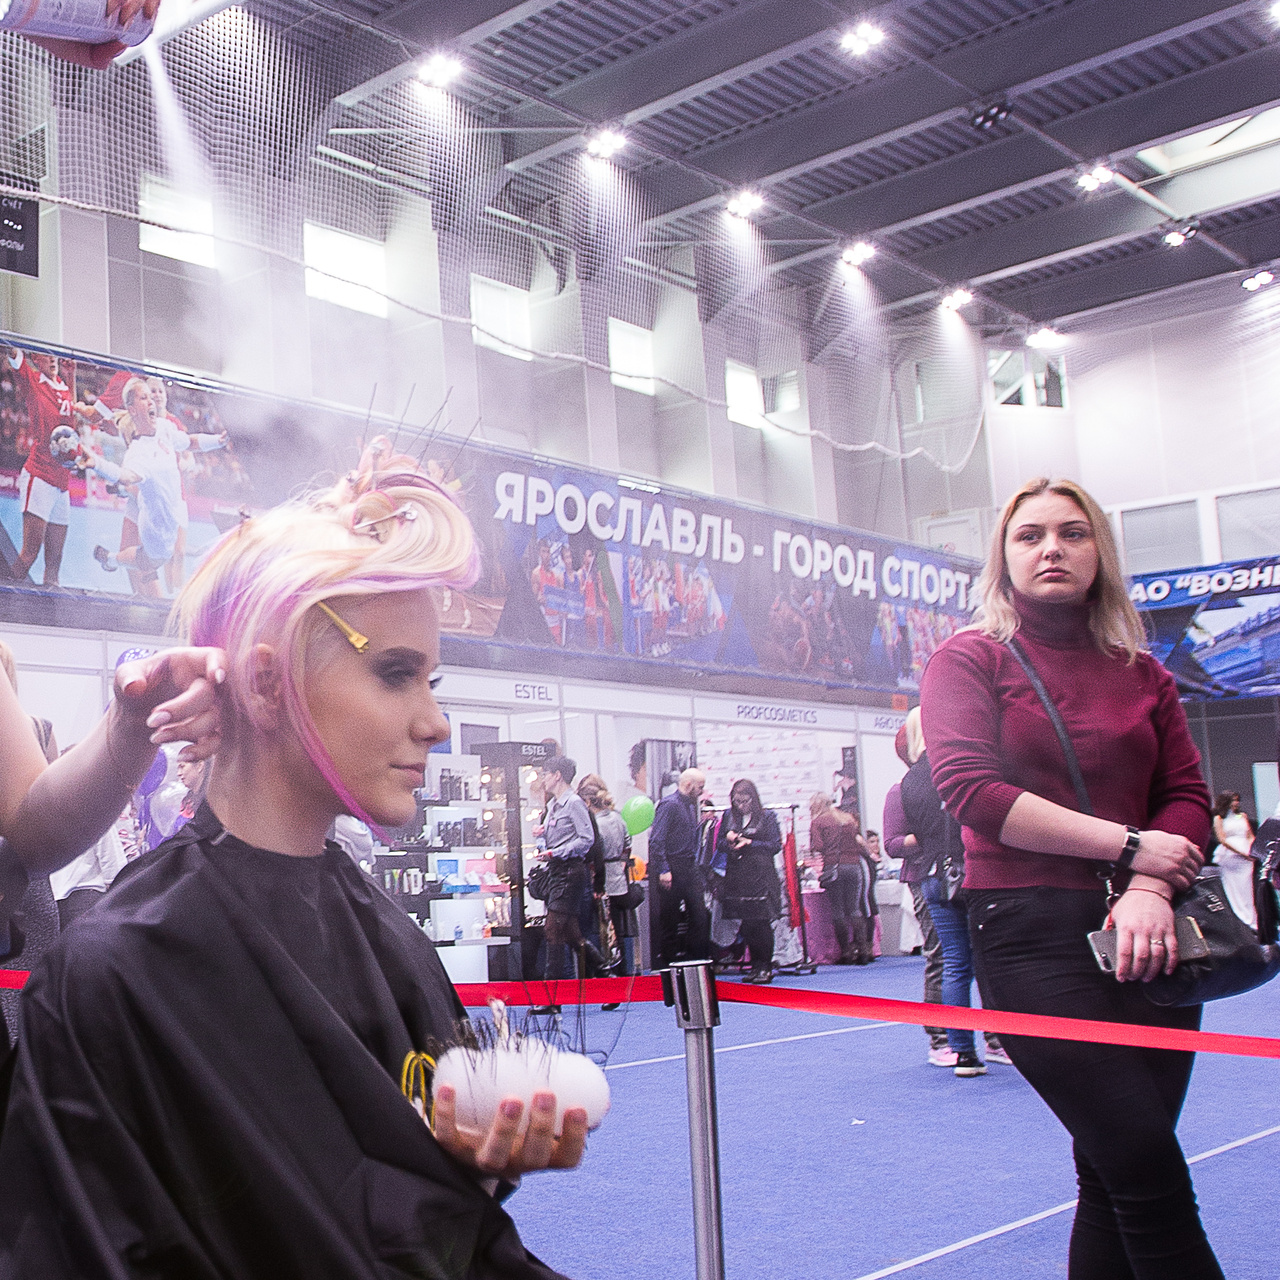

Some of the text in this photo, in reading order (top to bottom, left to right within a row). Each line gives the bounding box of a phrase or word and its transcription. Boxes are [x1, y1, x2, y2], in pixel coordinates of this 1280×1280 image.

[0, 239, 24, 251] ФОЛЫ
[493, 472, 745, 564] ЯРОСЛАВЛЬ
[773, 529, 877, 600] ГОРОД
[514, 683, 553, 701] ESTEL
[737, 705, 817, 723] PROFCOSMETICS
[522, 744, 547, 756] ESTEL
